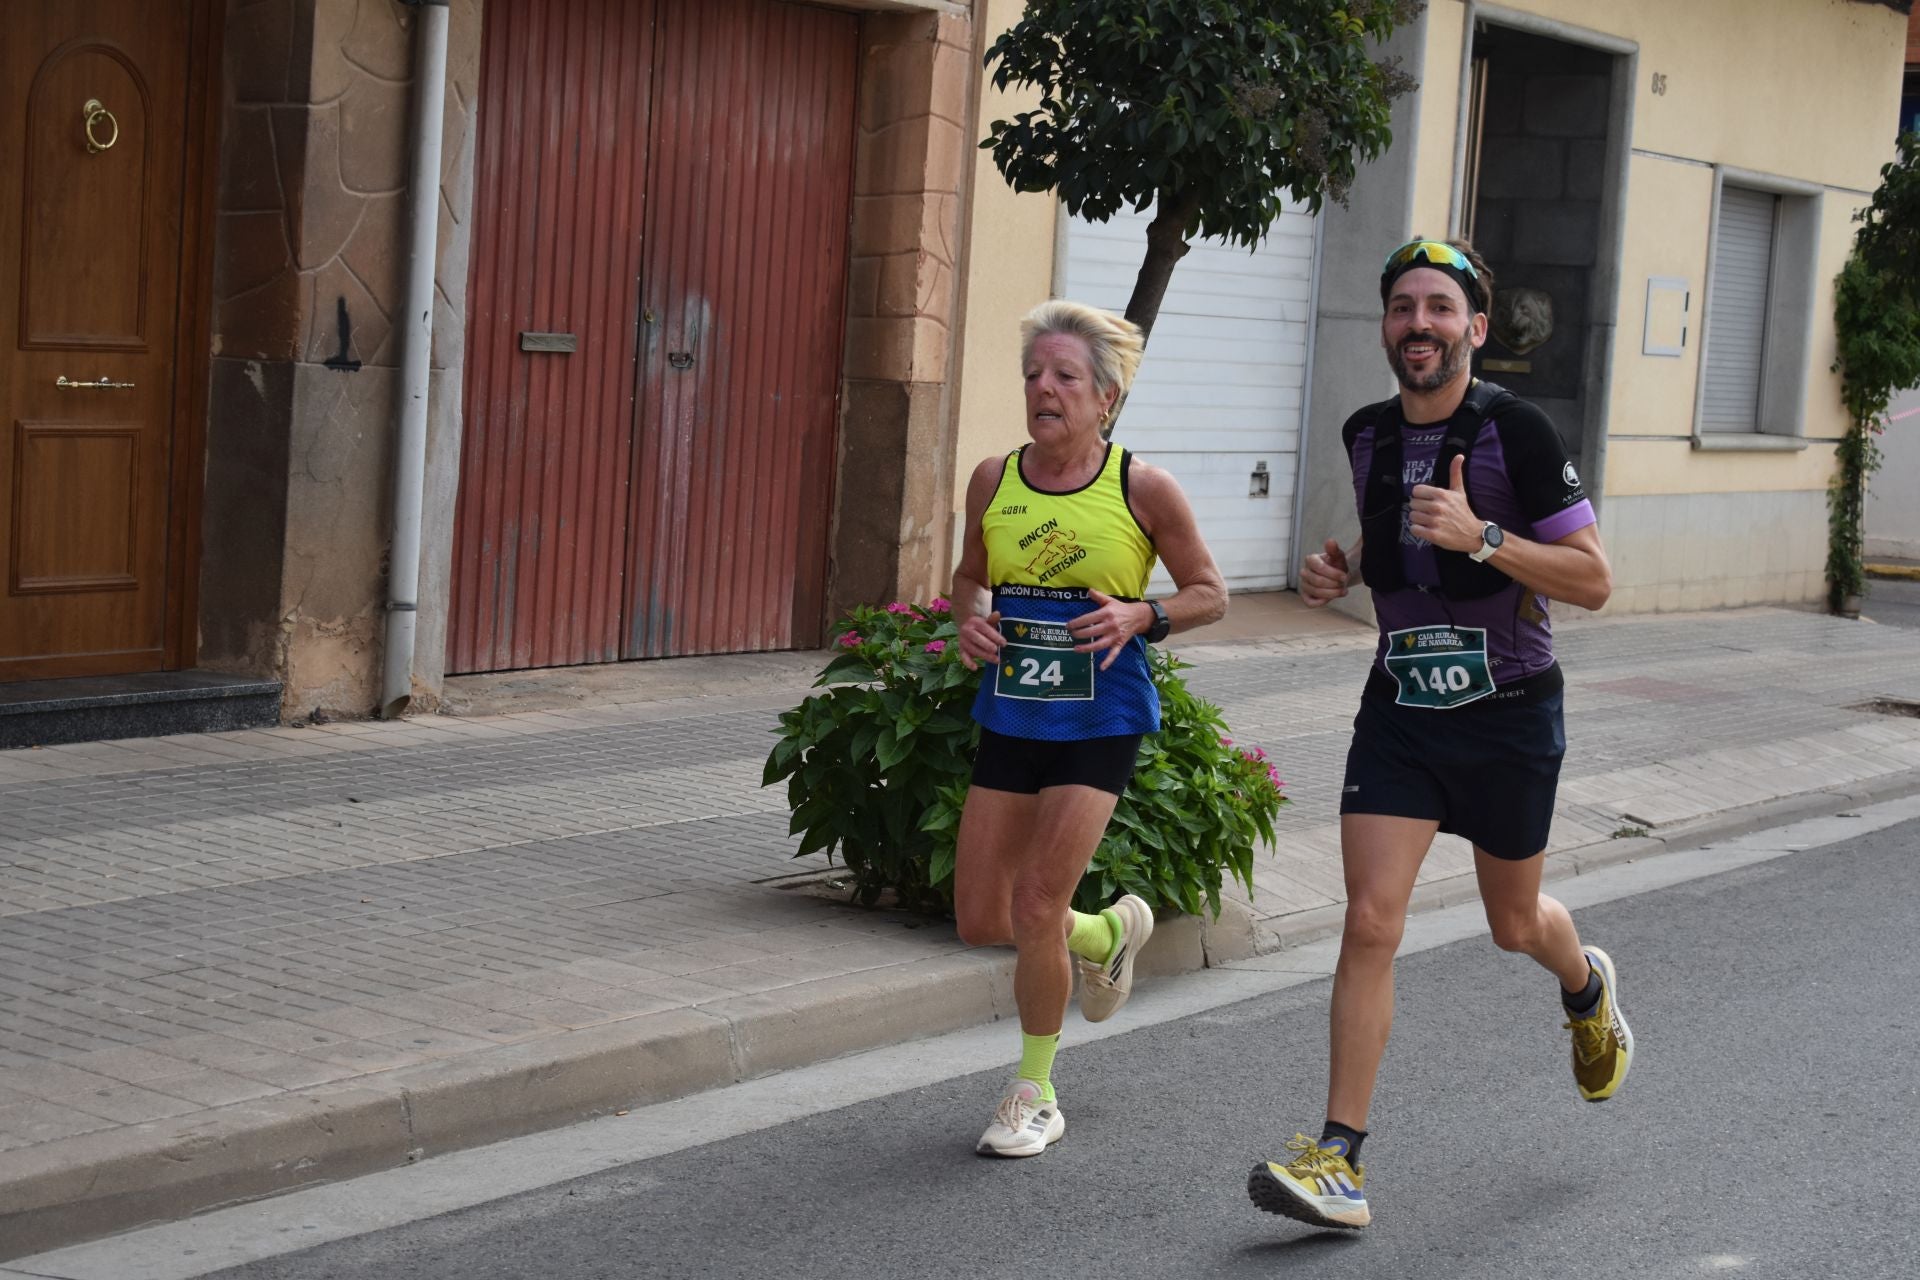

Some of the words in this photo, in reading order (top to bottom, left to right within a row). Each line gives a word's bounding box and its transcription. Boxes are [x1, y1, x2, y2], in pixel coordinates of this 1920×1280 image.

[1001, 505, 1028, 515] GOBIK
[1018, 518, 1058, 551] RINCON
[1038, 548, 1087, 584] ATLETISMO
[1033, 588, 1046, 598] DE
[1040, 634, 1073, 643] NAVARRA
[1435, 631, 1460, 640] RURAL
[1417, 640, 1427, 648] DE
[1429, 638, 1464, 648] NAVARRA
[1019, 658, 1064, 686] 24
[1408, 665, 1471, 695] 140
